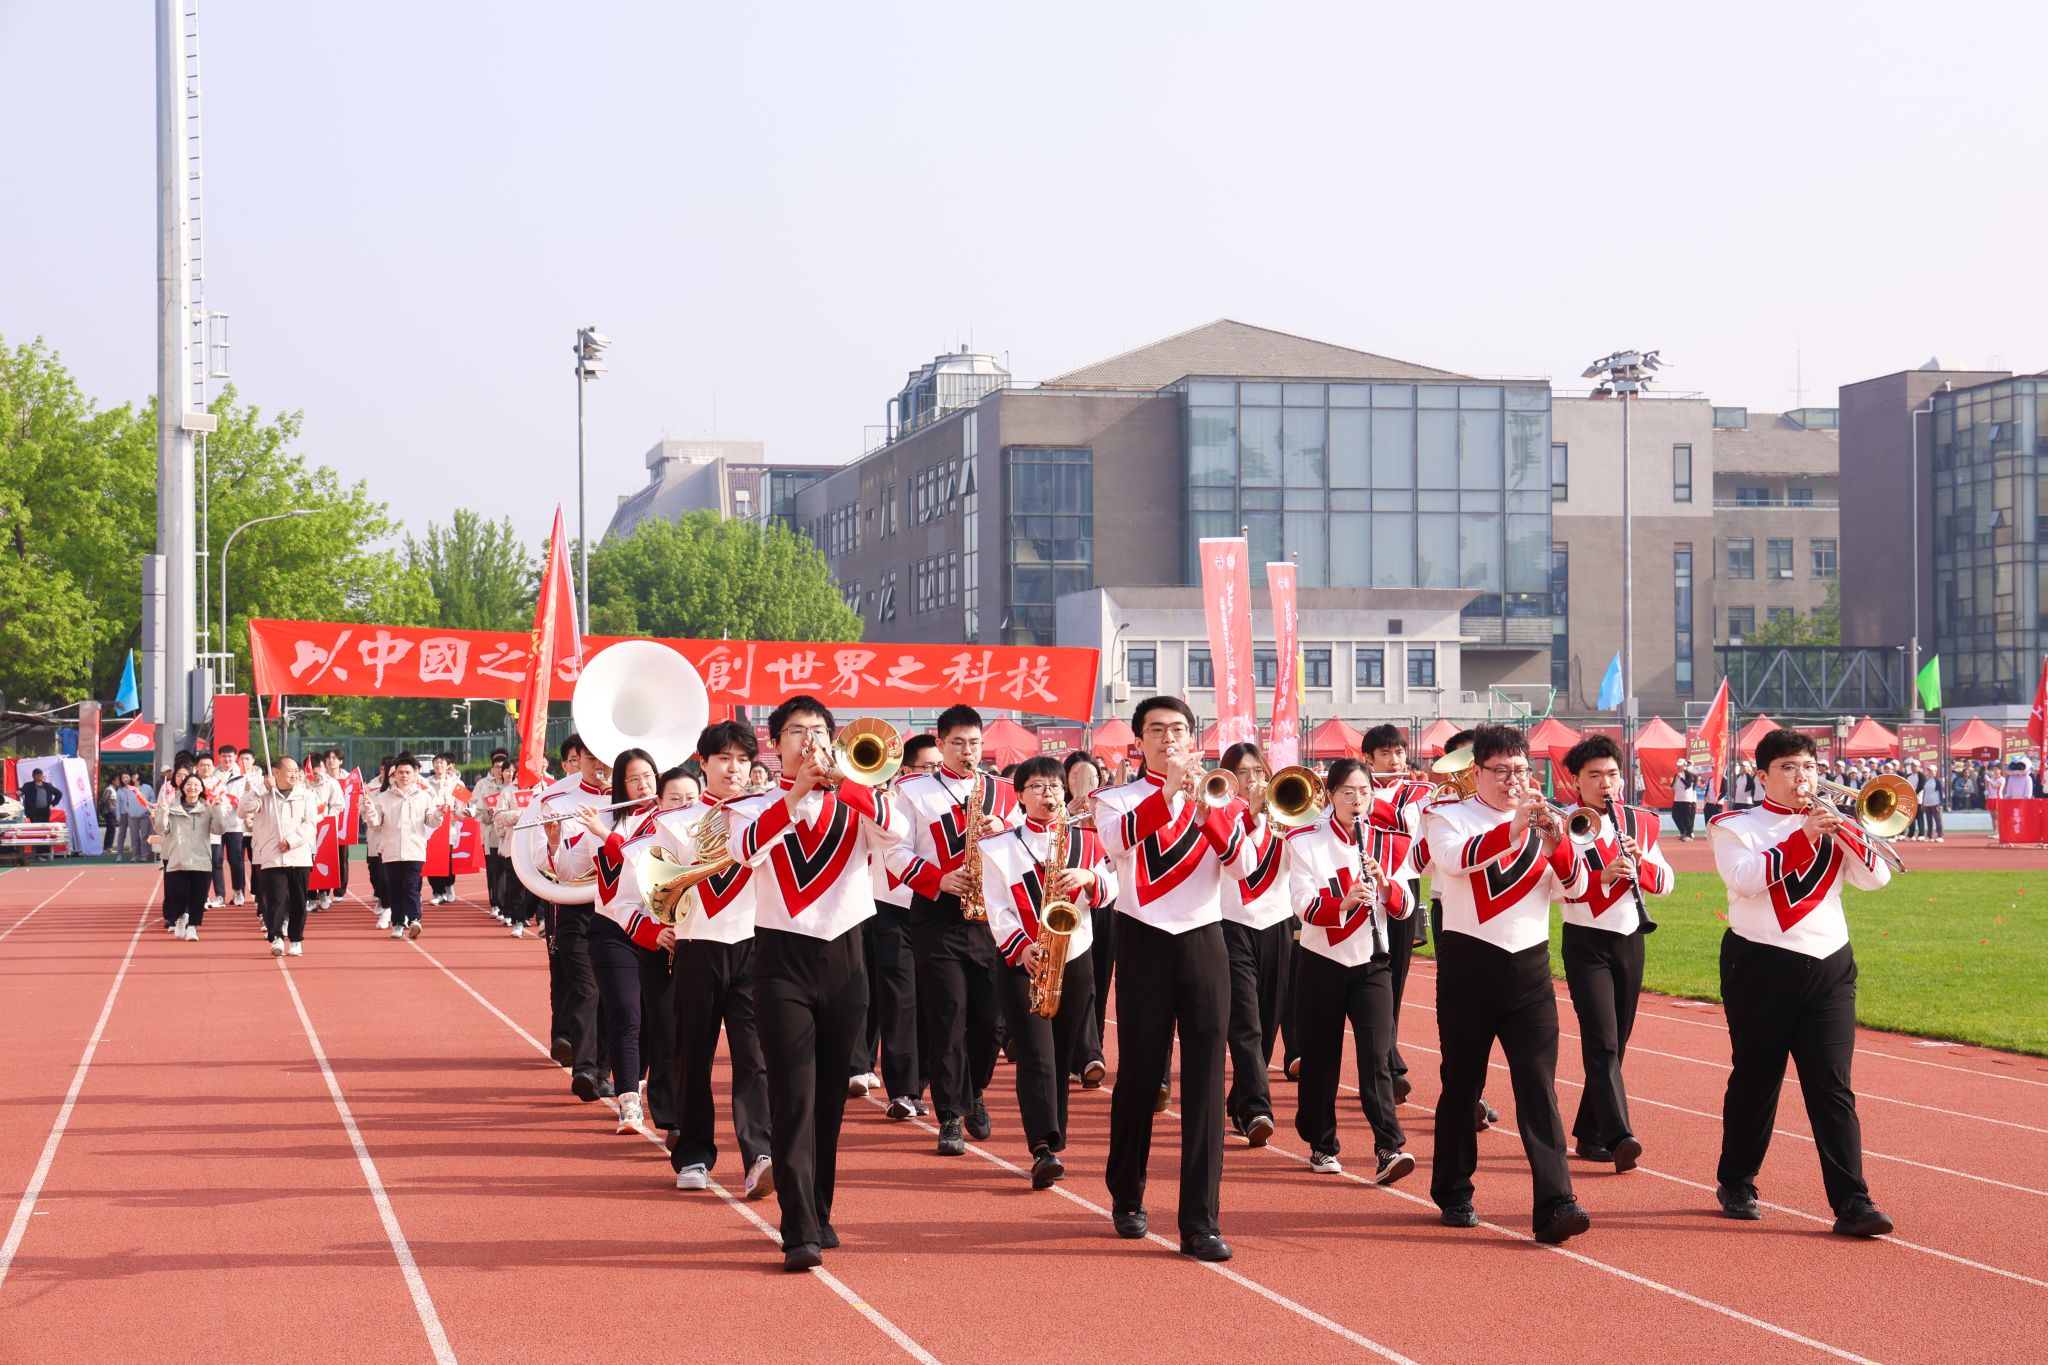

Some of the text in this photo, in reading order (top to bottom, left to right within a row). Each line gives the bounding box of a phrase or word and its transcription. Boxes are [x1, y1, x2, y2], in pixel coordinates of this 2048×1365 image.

[696, 644, 1059, 703] 創世界之科技
